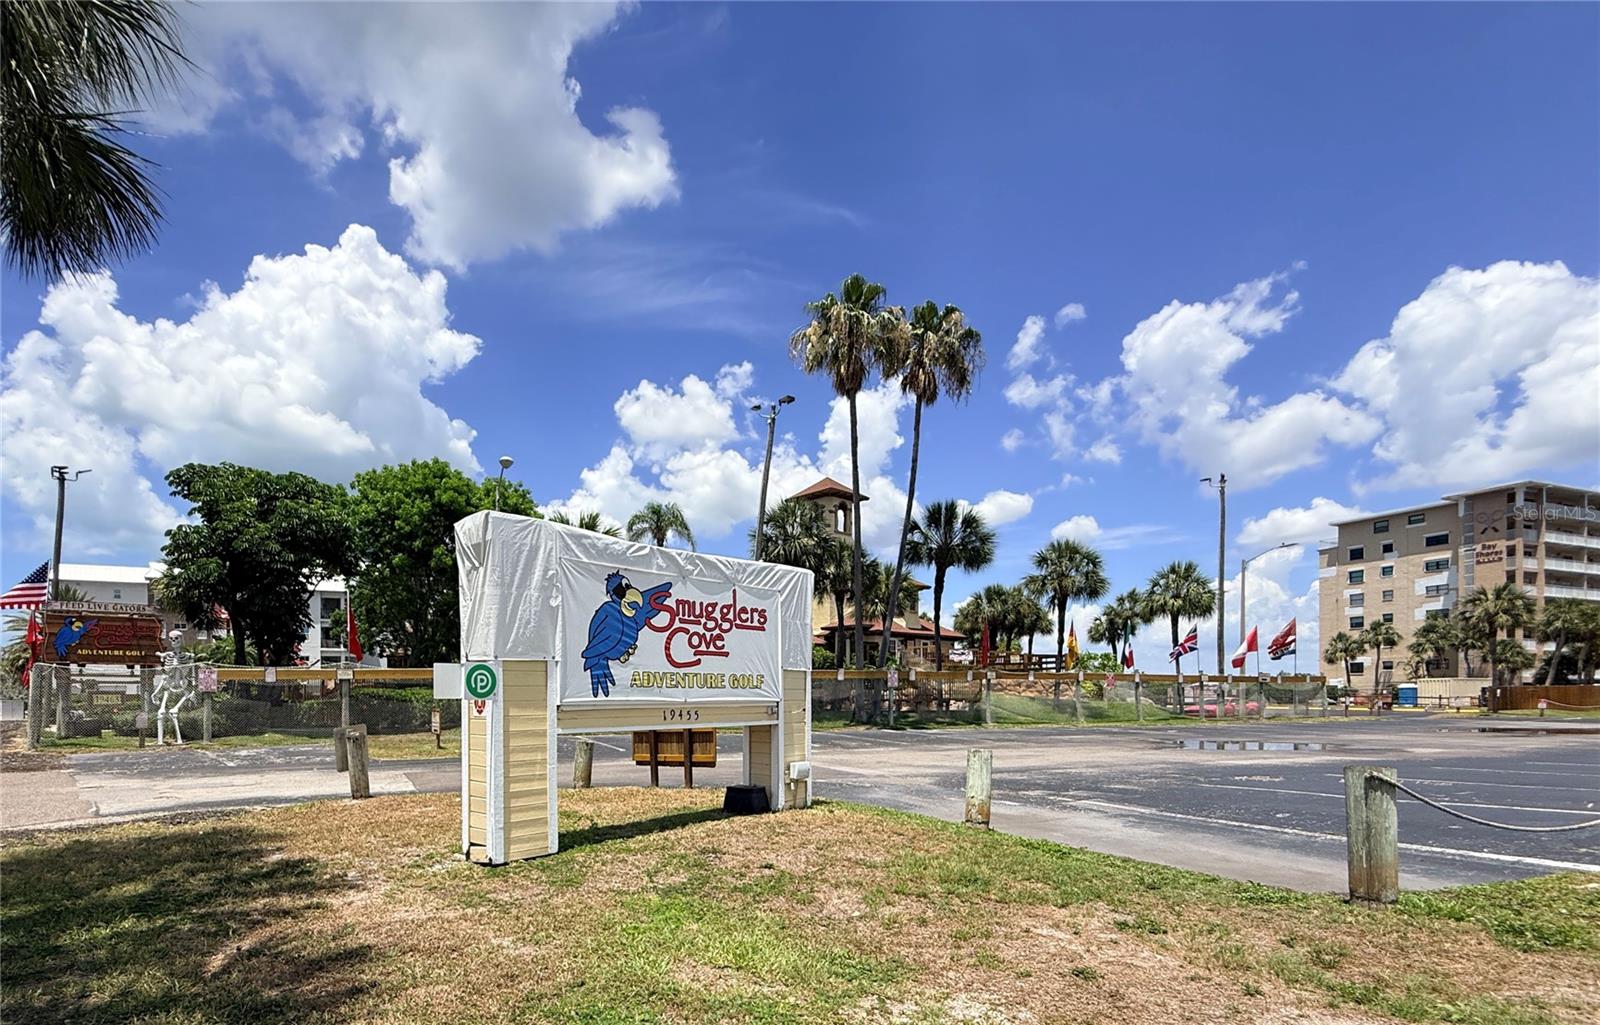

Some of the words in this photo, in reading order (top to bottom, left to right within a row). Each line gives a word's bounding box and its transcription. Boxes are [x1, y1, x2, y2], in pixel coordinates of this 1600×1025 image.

[112, 603, 146, 612] GATORS
[645, 588, 768, 634] Smugglers
[664, 626, 729, 669] Cove
[630, 670, 726, 689] ADVENTURE
[728, 673, 765, 690] GOLF
[662, 709, 700, 721] 19455
